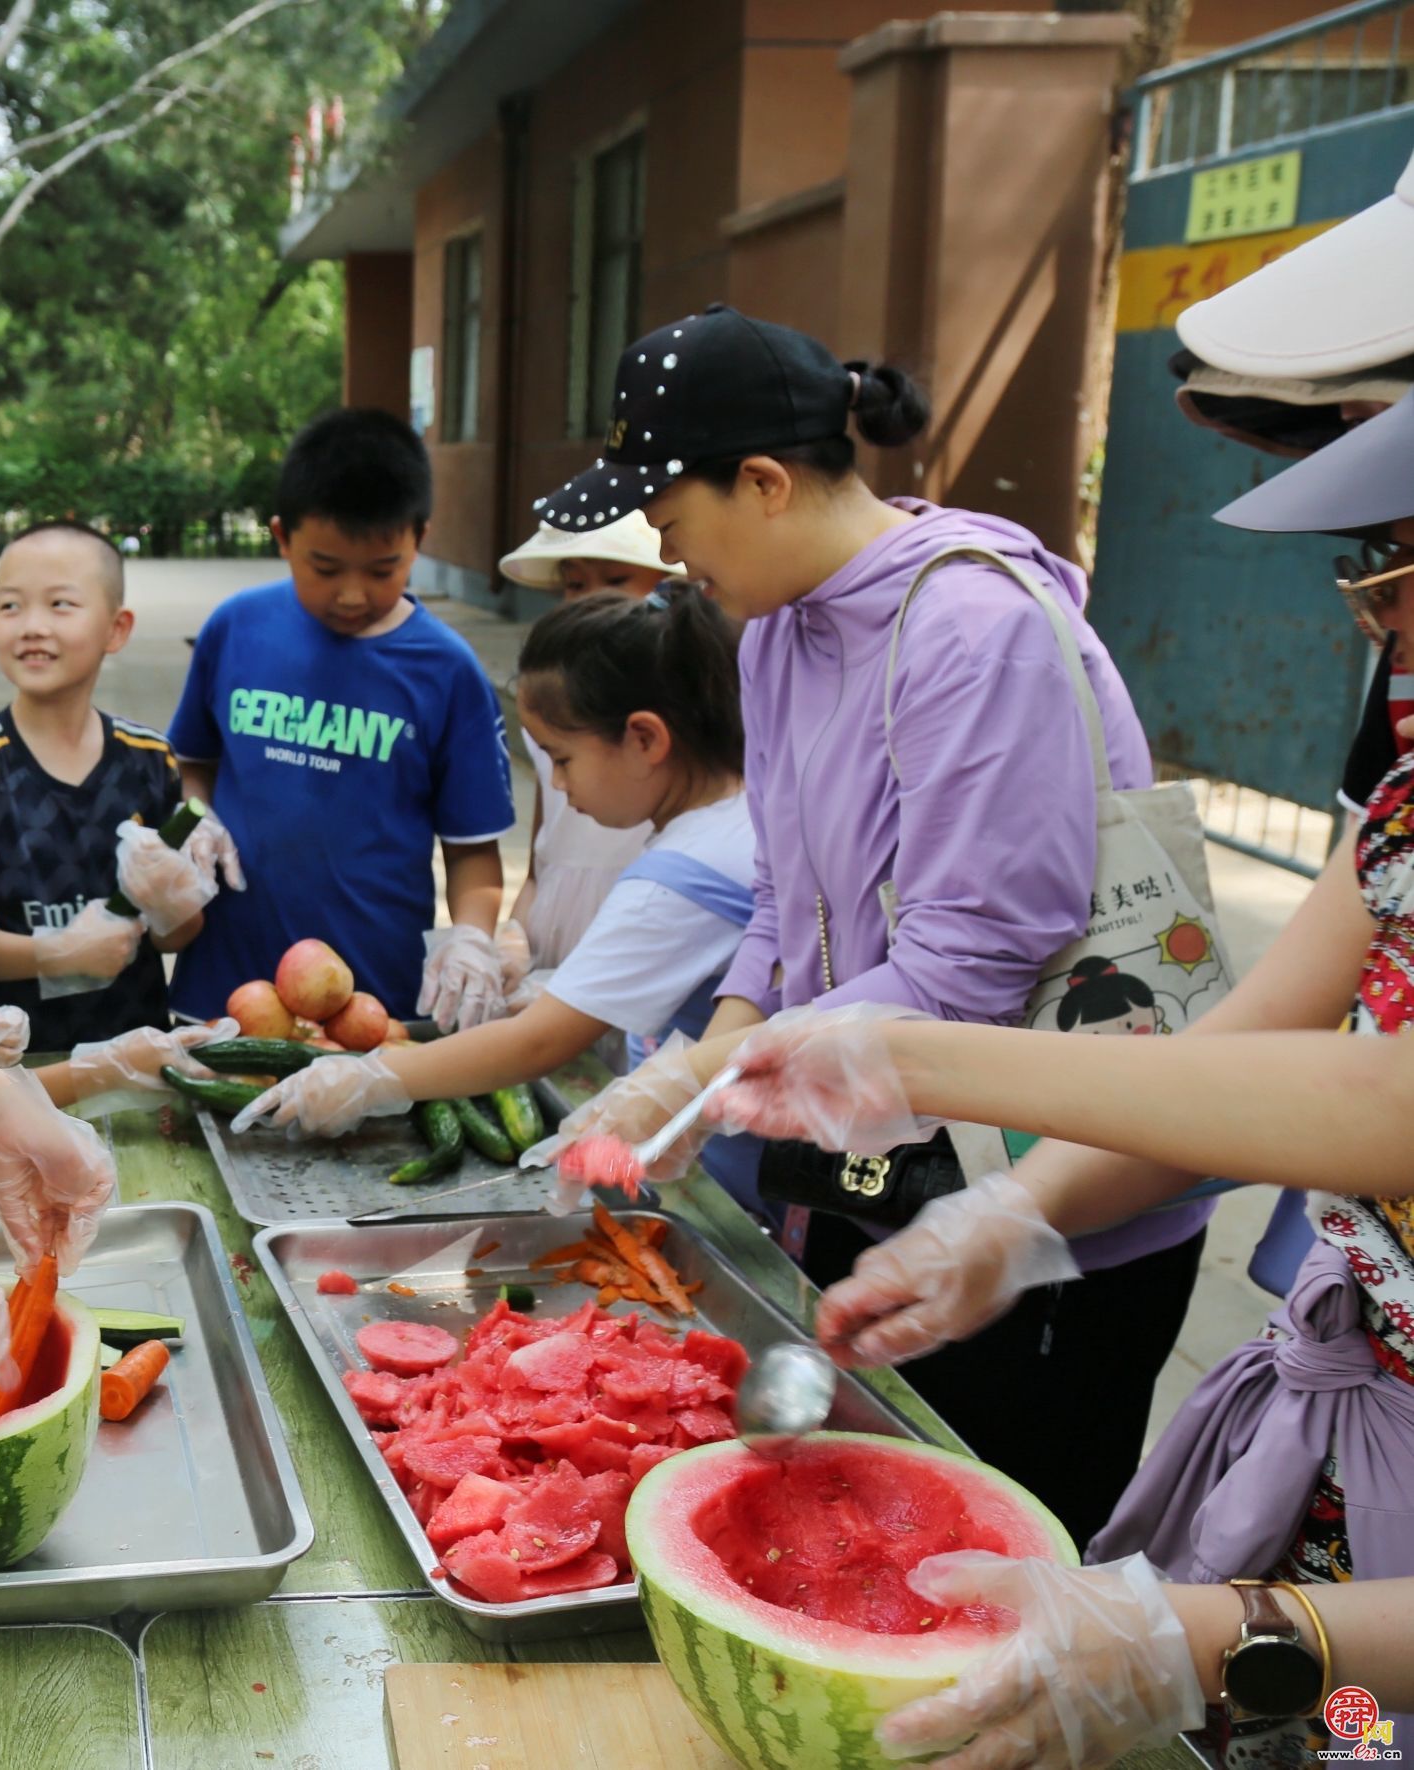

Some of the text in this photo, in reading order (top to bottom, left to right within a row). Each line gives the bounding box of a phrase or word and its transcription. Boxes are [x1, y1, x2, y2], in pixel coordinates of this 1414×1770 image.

[229, 688, 405, 763] GERMANY
[265, 746, 341, 774] WORLD TOUR
